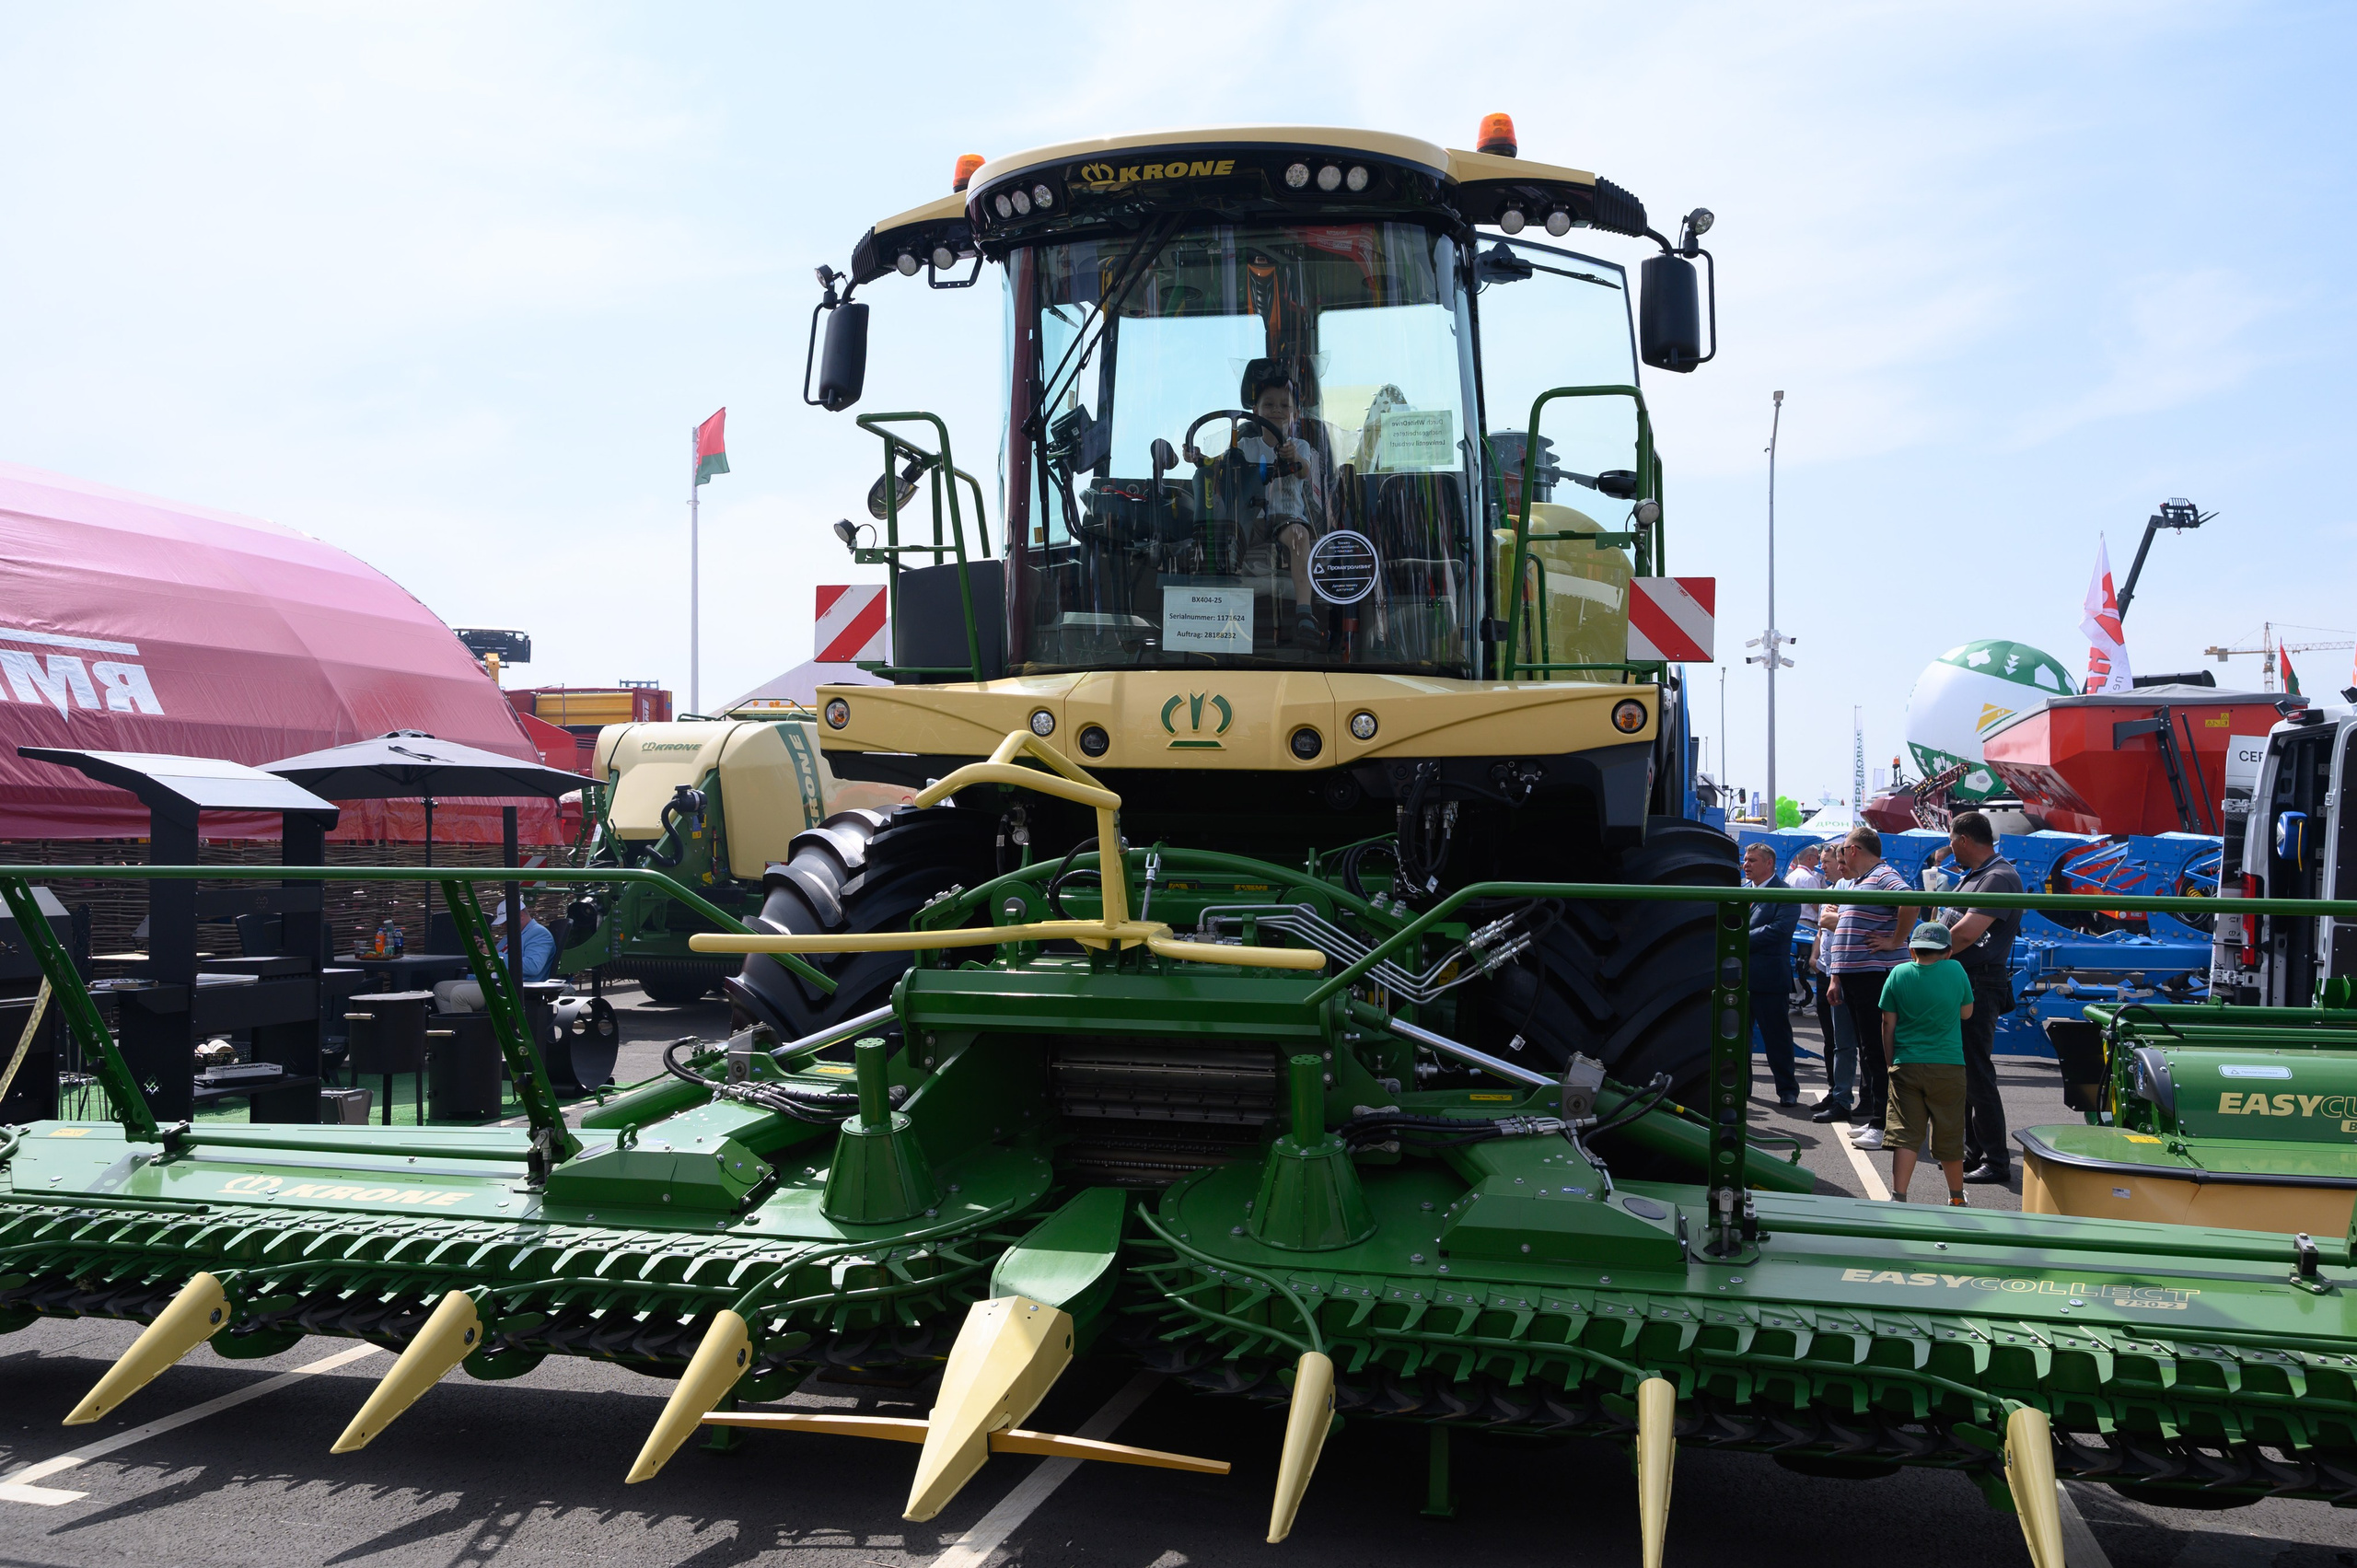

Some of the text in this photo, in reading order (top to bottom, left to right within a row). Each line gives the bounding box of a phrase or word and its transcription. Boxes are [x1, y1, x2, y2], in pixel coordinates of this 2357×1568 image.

[1119, 159, 1236, 183] KRONE
[1191, 596, 1223, 604] BX404-25
[1168, 612, 1215, 621] Serialnummer:
[1177, 631, 1203, 639] Auftrag:
[655, 743, 703, 751] KRONE
[1816, 820, 1850, 829] ДРОН
[278, 1182, 475, 1206] KRONE
[1840, 1268, 2200, 1303] EASYCOLLECT
[2123, 1298, 2178, 1309] 750-2
